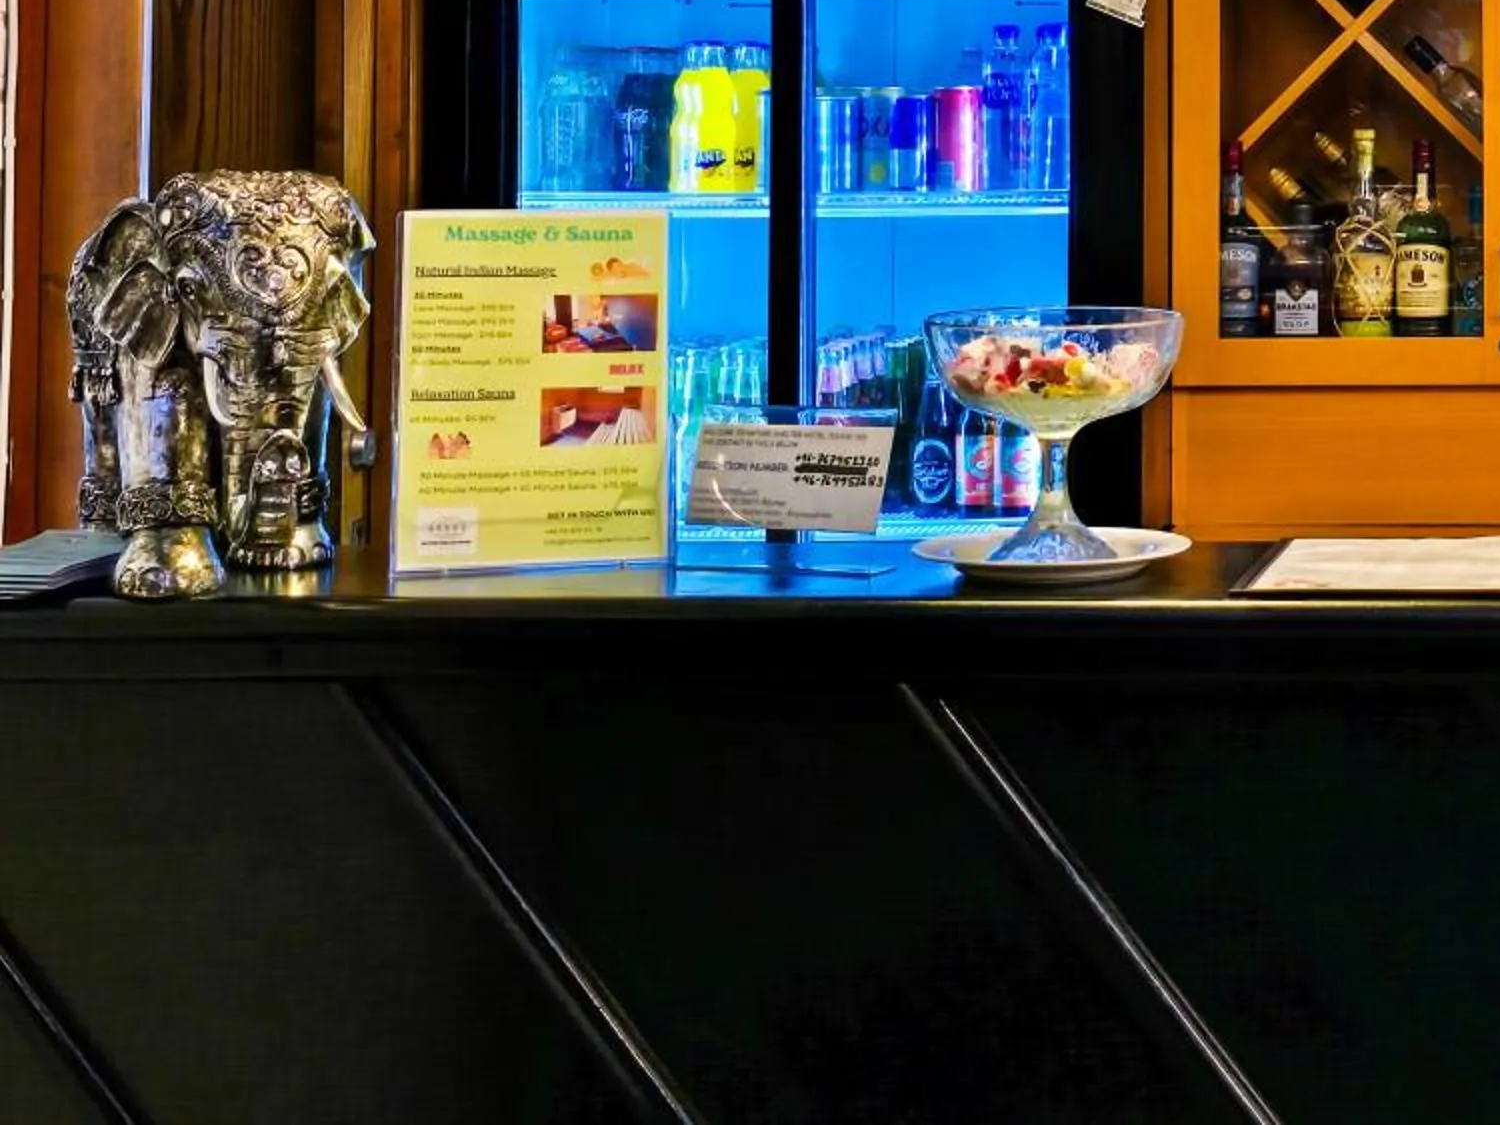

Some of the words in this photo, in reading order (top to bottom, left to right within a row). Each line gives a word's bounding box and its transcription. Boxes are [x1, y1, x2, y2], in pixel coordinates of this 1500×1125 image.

[446, 226, 537, 244] Massage
[544, 226, 559, 241] &
[566, 226, 634, 241] Sauna
[415, 265, 462, 277] Natural
[464, 264, 503, 277] Indian
[505, 265, 557, 279] Massage
[477, 388, 516, 401] Sauna
